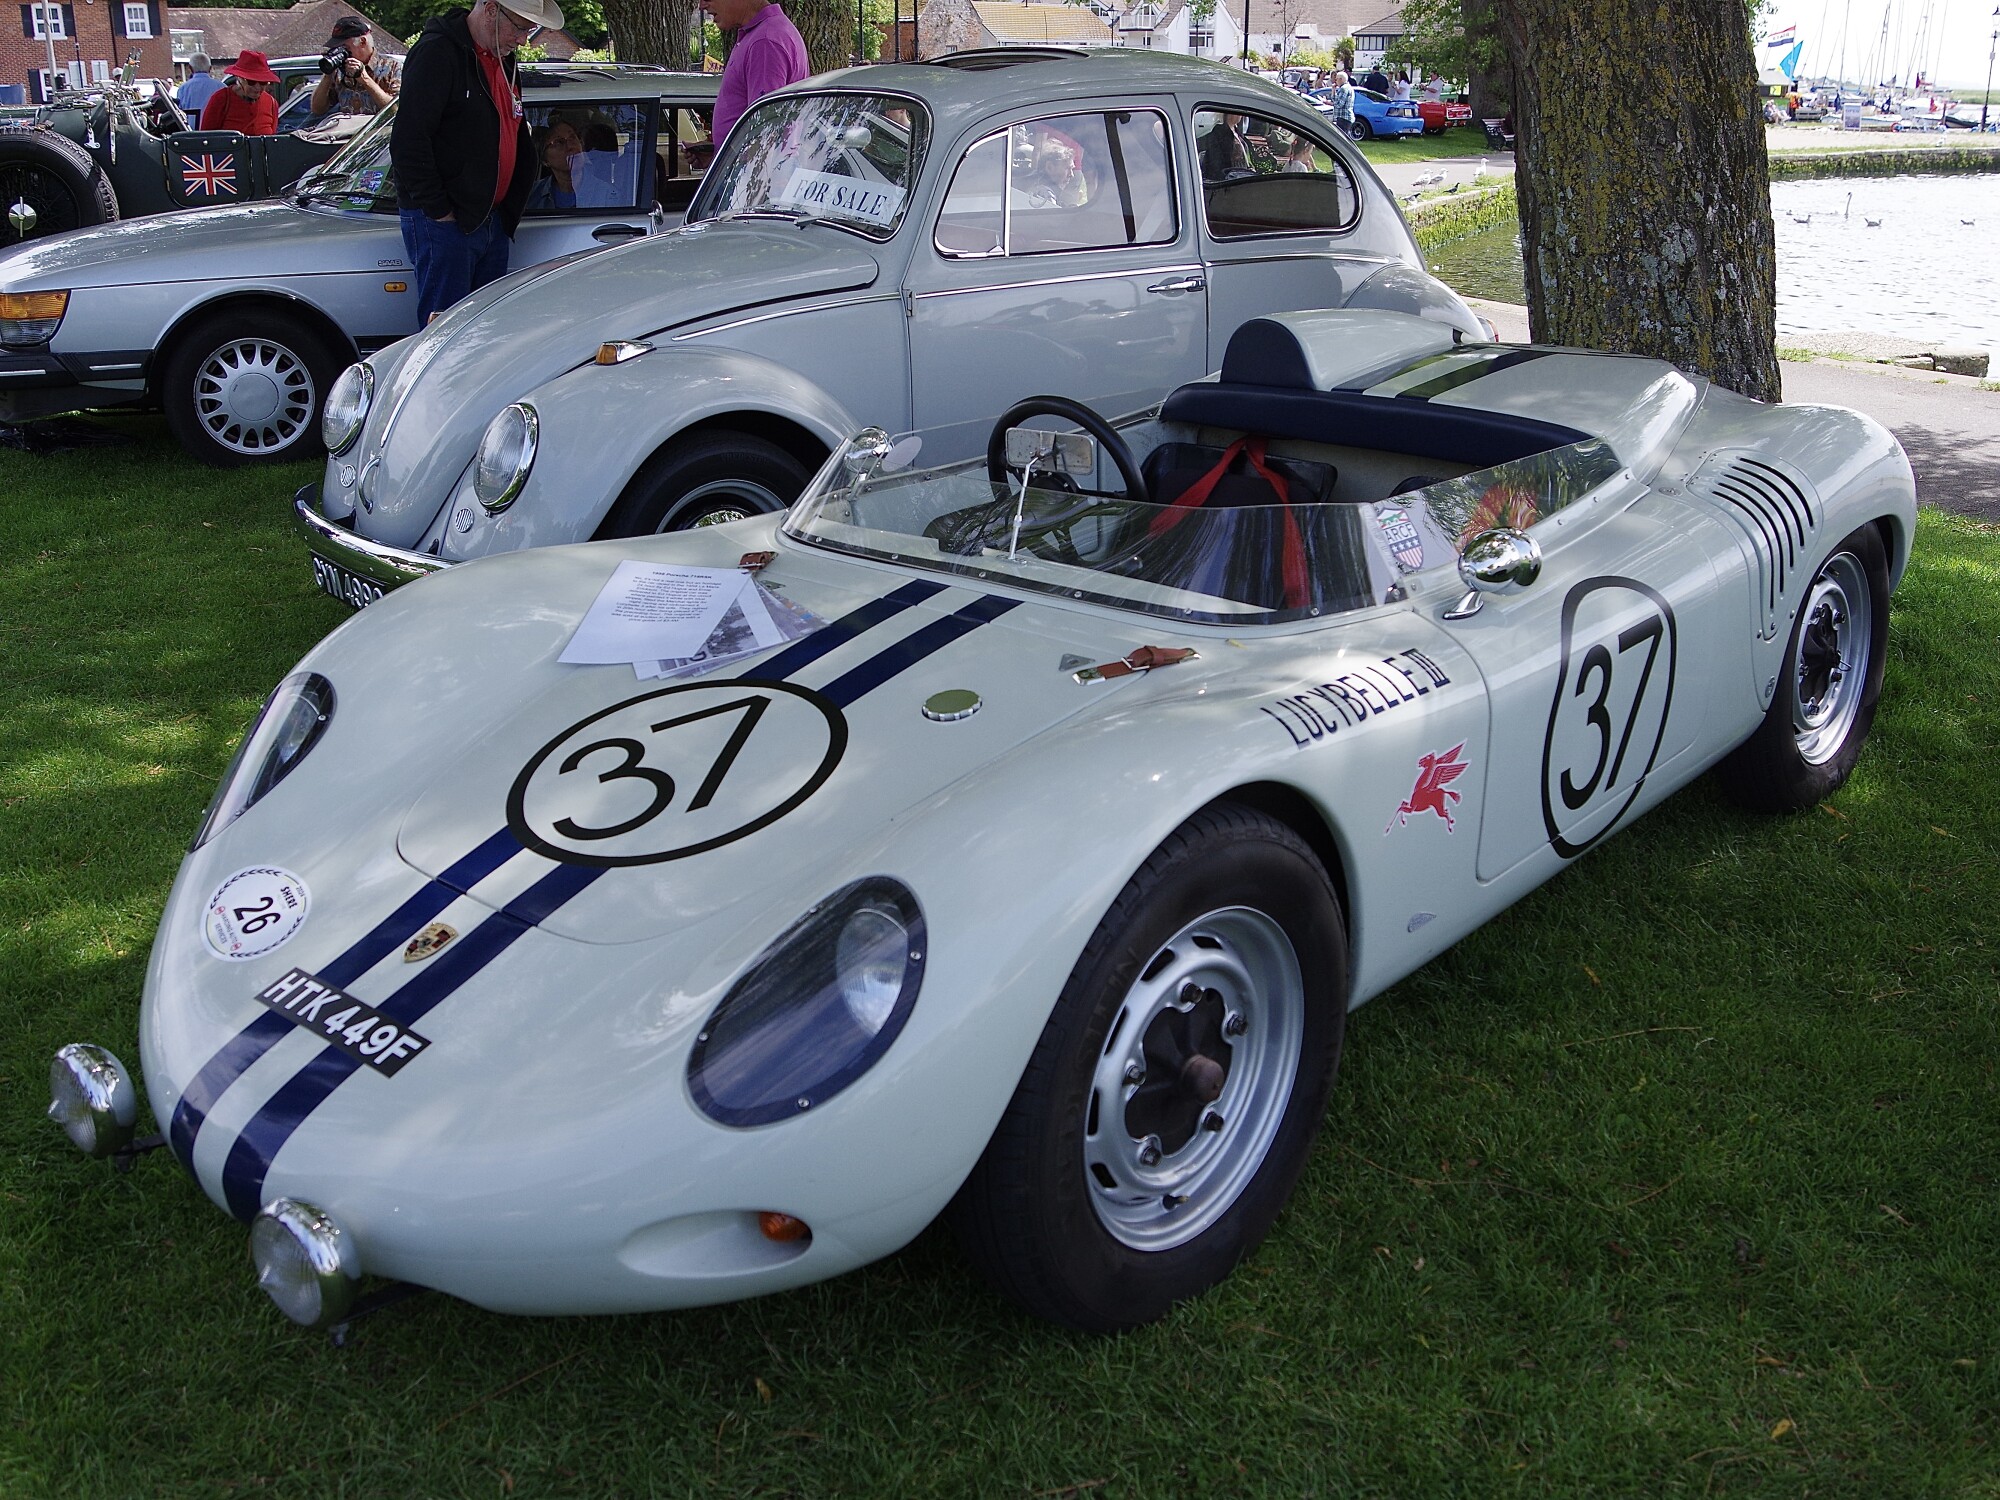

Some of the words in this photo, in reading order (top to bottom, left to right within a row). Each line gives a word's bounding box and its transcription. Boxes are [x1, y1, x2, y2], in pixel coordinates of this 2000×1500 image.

[793, 180, 830, 203] FOR
[832, 186, 888, 216] SALE
[1385, 523, 1414, 542] ARCF
[1260, 656, 1430, 751] LUCYBELLE
[1560, 613, 1664, 811] 37
[552, 694, 773, 841] 37
[233, 896, 282, 934] 26
[280, 886, 299, 909] SHERE
[263, 972, 342, 1023] HTK
[323, 1005, 423, 1066] 449F
